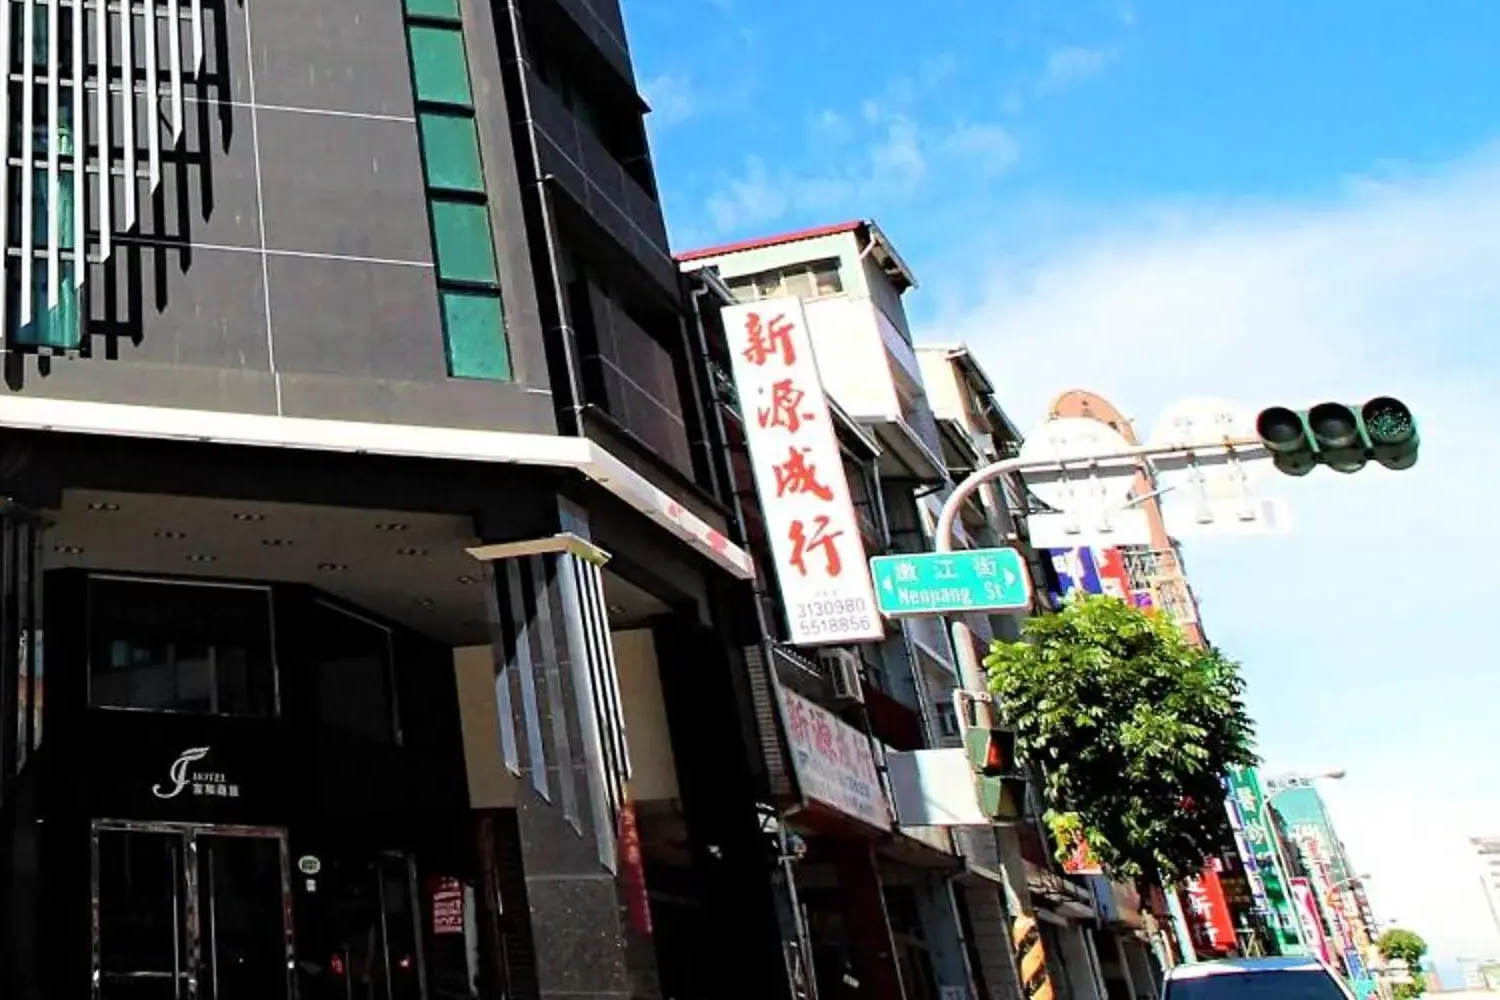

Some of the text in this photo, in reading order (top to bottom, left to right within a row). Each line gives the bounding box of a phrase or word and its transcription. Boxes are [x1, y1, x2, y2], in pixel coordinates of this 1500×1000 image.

[898, 580, 1004, 606] Nenjiang St
[797, 597, 866, 619] 3130980
[799, 615, 871, 636] 5518856
[192, 771, 228, 783] HOTEL
